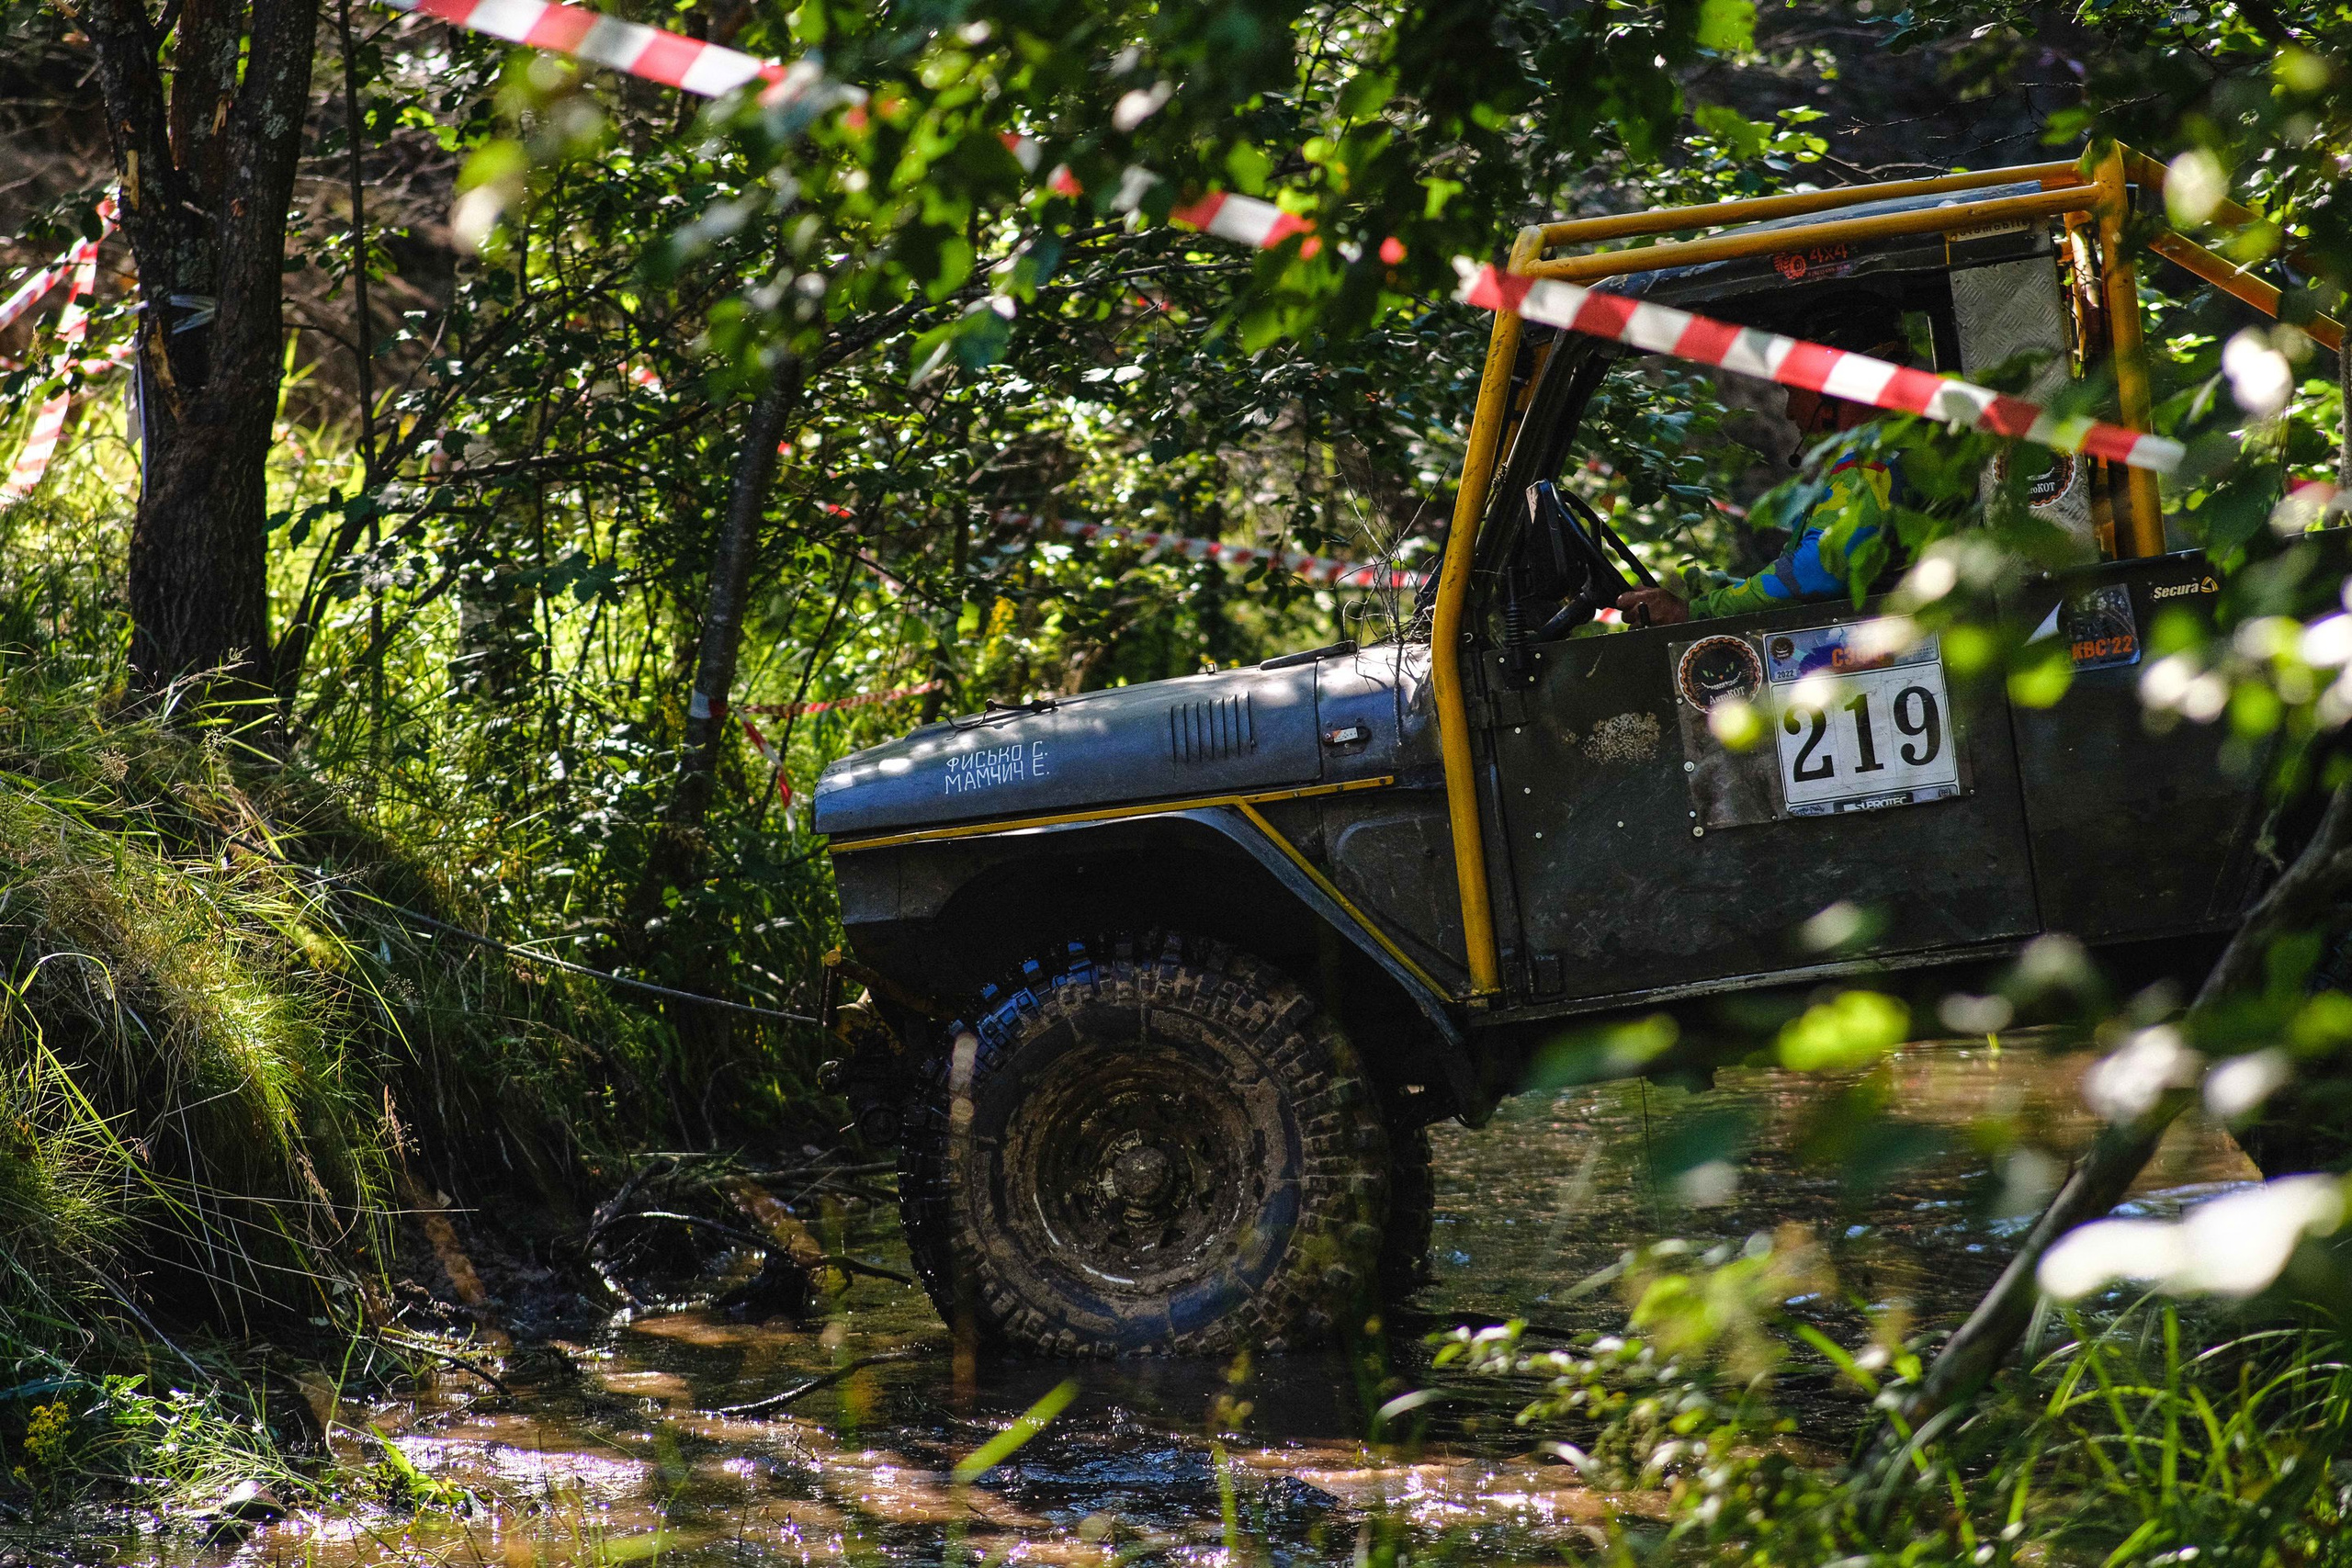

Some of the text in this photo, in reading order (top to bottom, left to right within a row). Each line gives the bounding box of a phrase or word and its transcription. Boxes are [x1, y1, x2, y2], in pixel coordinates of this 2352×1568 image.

[2153, 582, 2199, 598] Secura
[1777, 670, 1794, 679] 2022
[1709, 686, 1746, 705] АвтоКОТ
[1783, 686, 1941, 783] 219
[946, 745, 1022, 773] ФИСЬКО
[944, 761, 1024, 794] МАМЧИЧ
